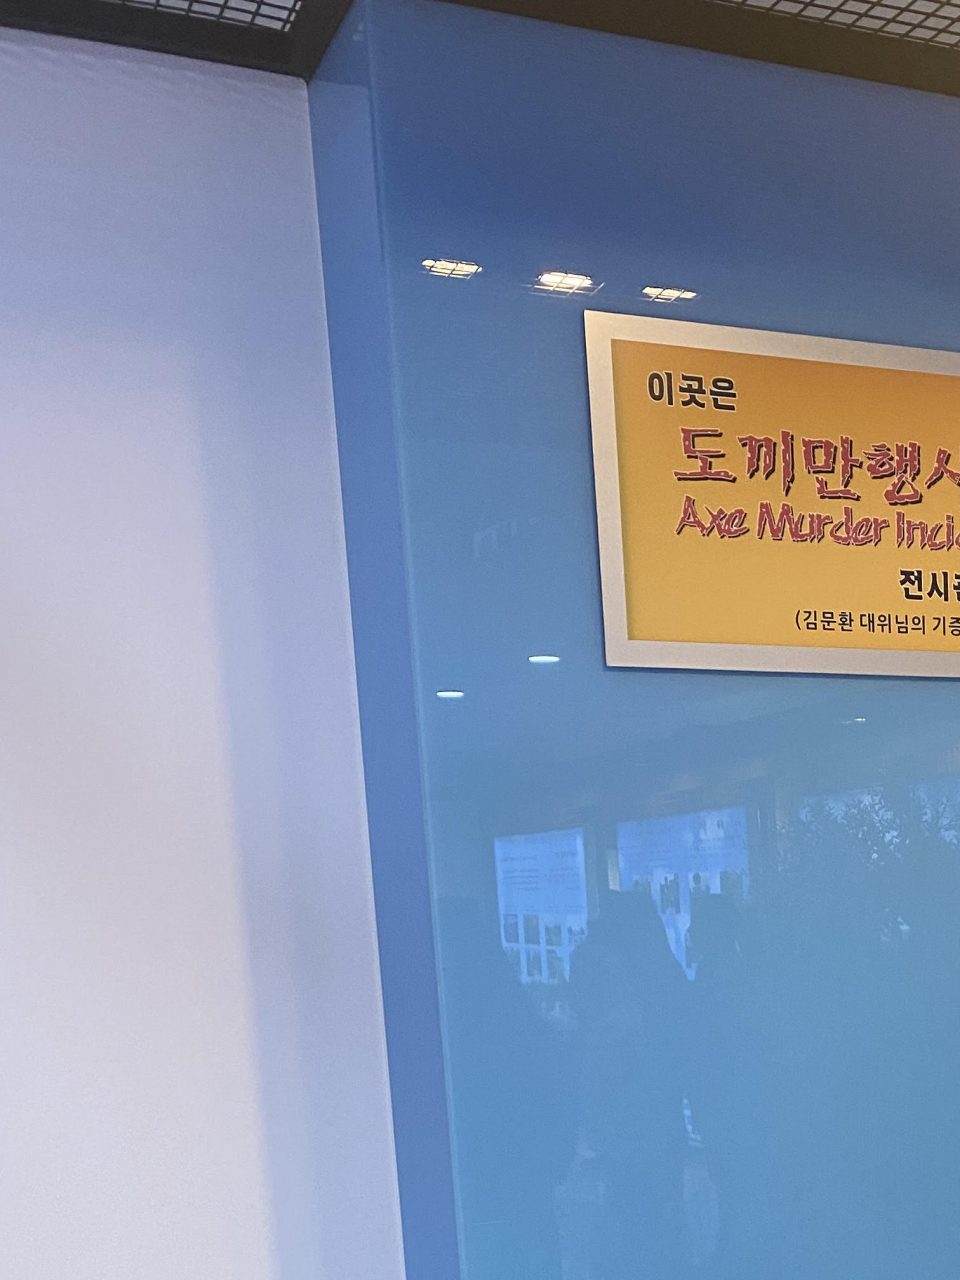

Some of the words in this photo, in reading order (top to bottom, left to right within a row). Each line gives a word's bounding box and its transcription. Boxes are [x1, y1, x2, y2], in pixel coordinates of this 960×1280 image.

[648, 371, 737, 410] 이곳은
[675, 495, 750, 540] Axe
[756, 500, 889, 548] Murder
[795, 609, 855, 632] (김문환
[859, 613, 926, 635] 대위님의
